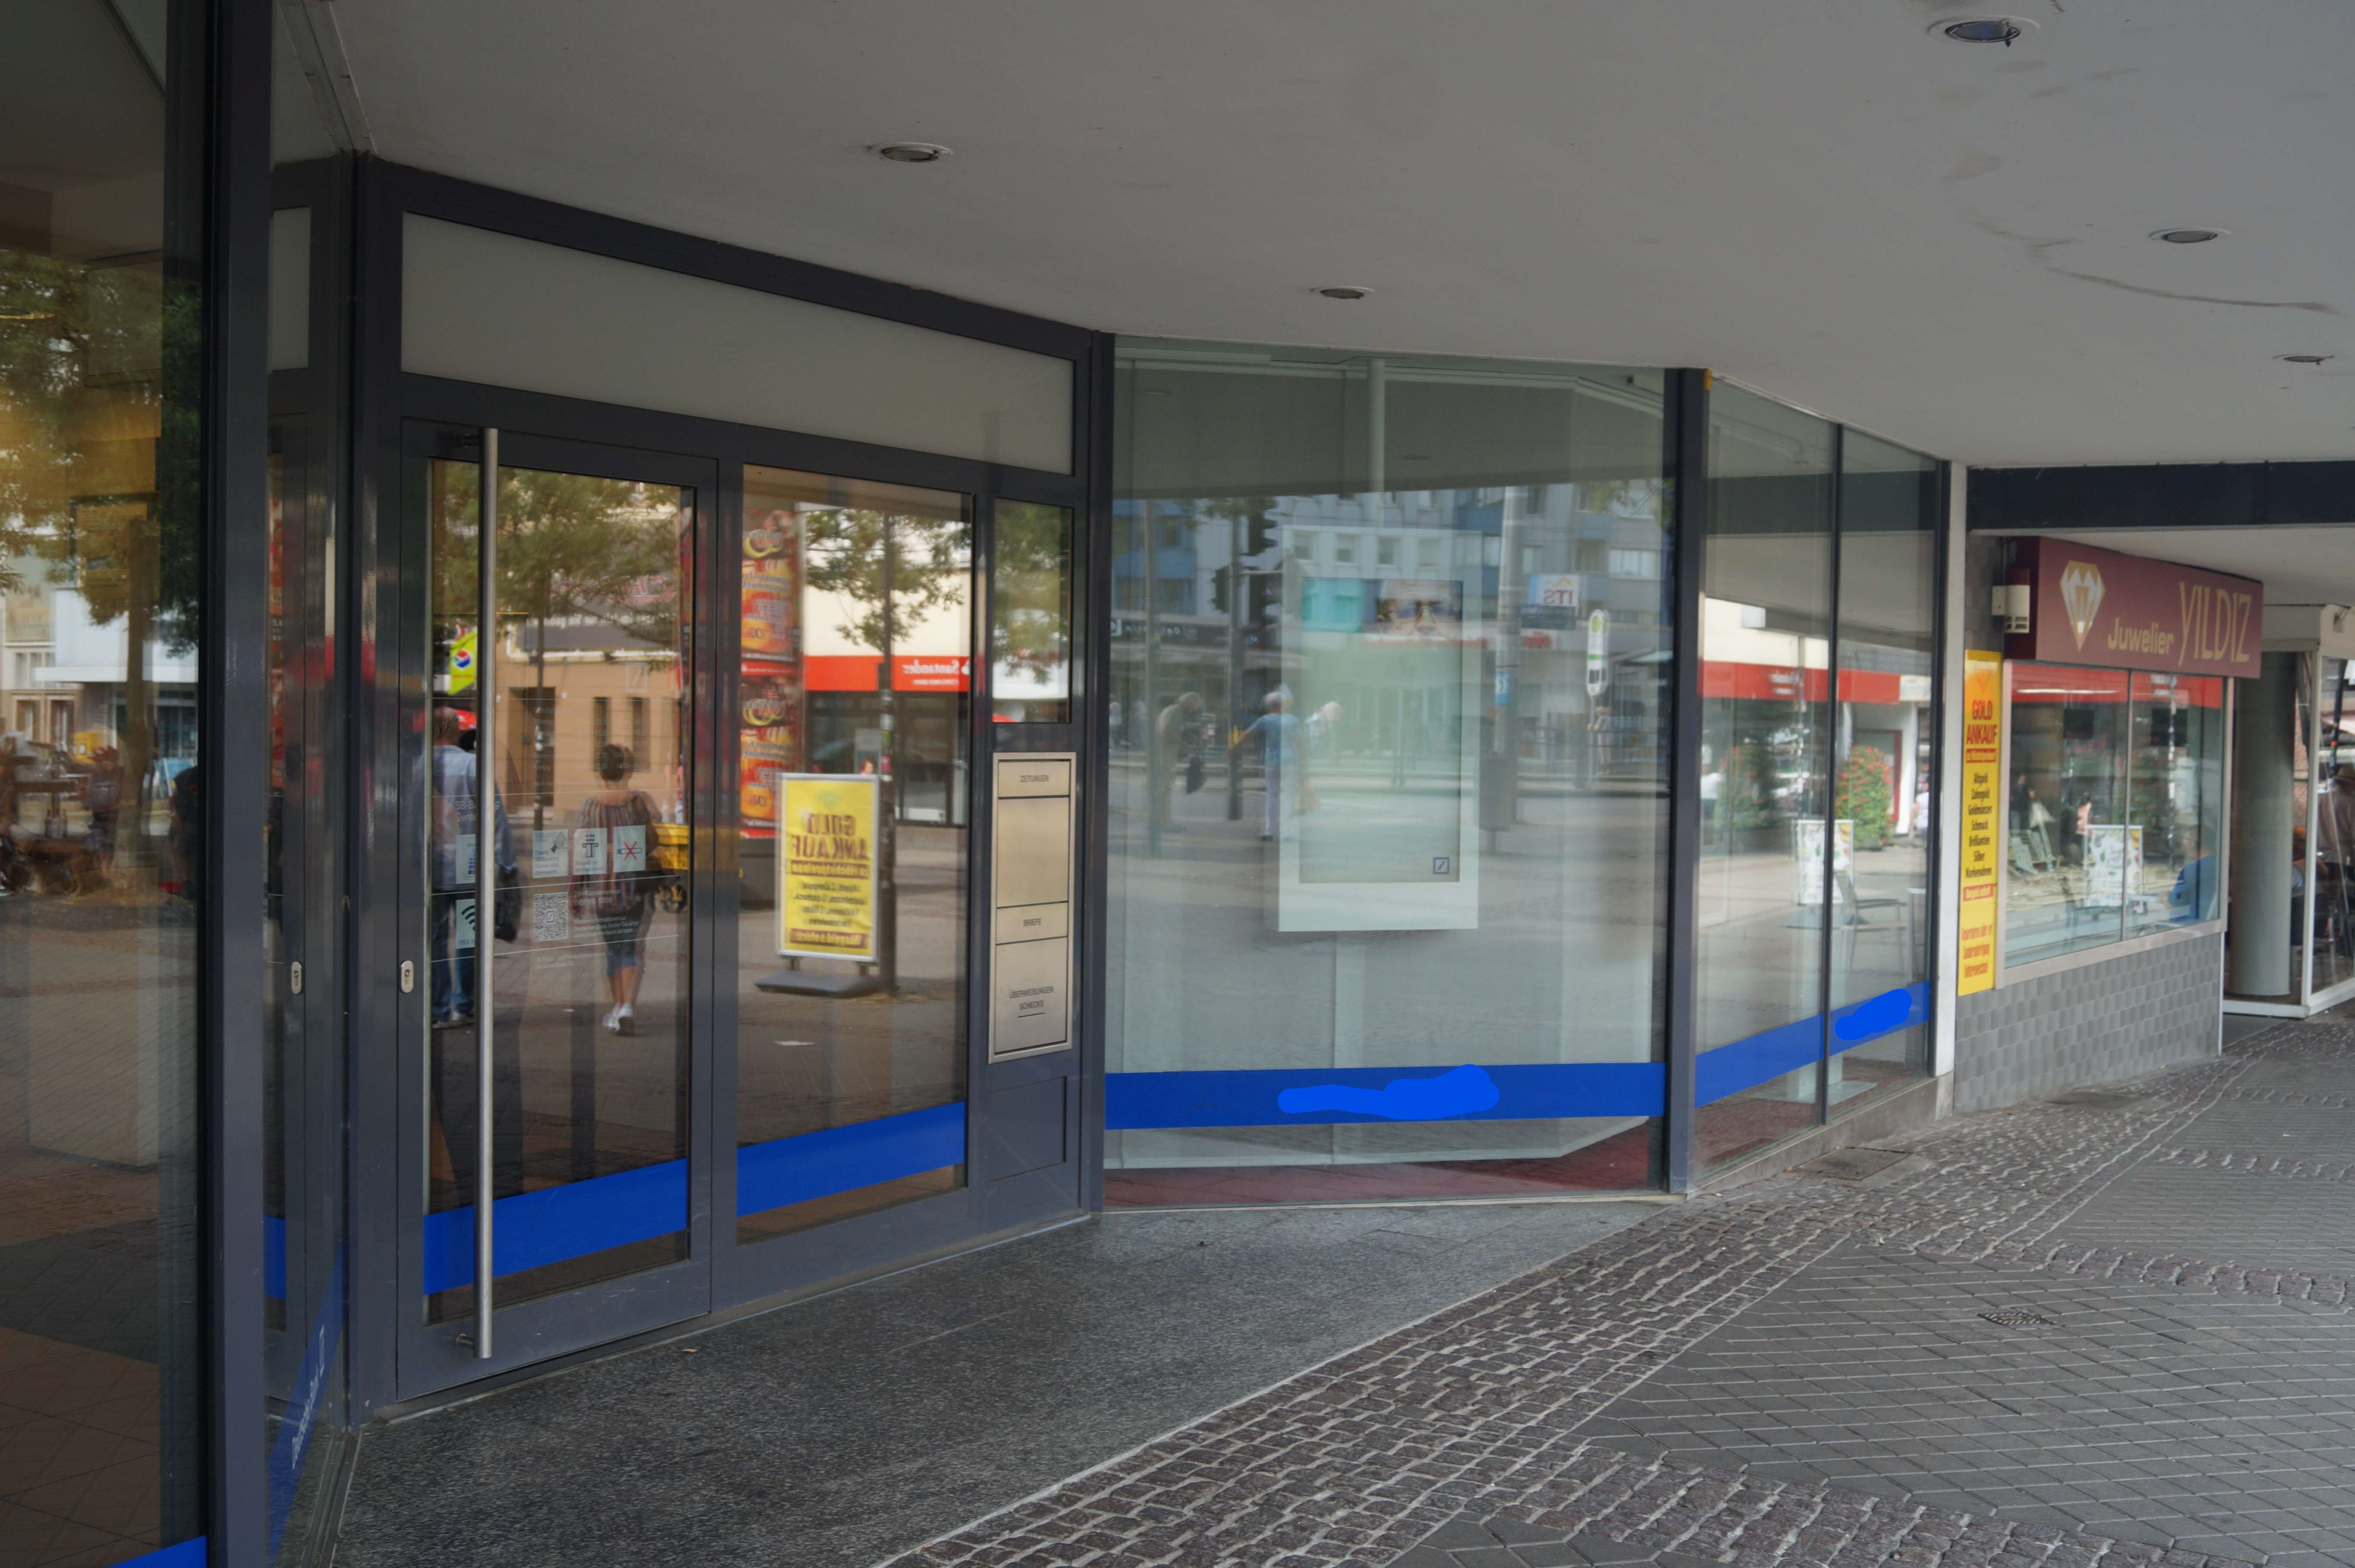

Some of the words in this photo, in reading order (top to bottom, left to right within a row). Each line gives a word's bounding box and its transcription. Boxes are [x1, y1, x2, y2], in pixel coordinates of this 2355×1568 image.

[2107, 617, 2175, 655] Juwelier
[2178, 581, 2252, 667] YILDIZ
[1972, 699, 1992, 720] GOLD
[1966, 724, 1997, 744] ANKAUF
[1020, 775, 1049, 783] ZEITUNGEN
[1023, 917, 1042, 927] BRIEFE
[1009, 985, 1054, 999] ÜBERWEISUNGEN
[1019, 1000, 1045, 1010] SCHECKS
